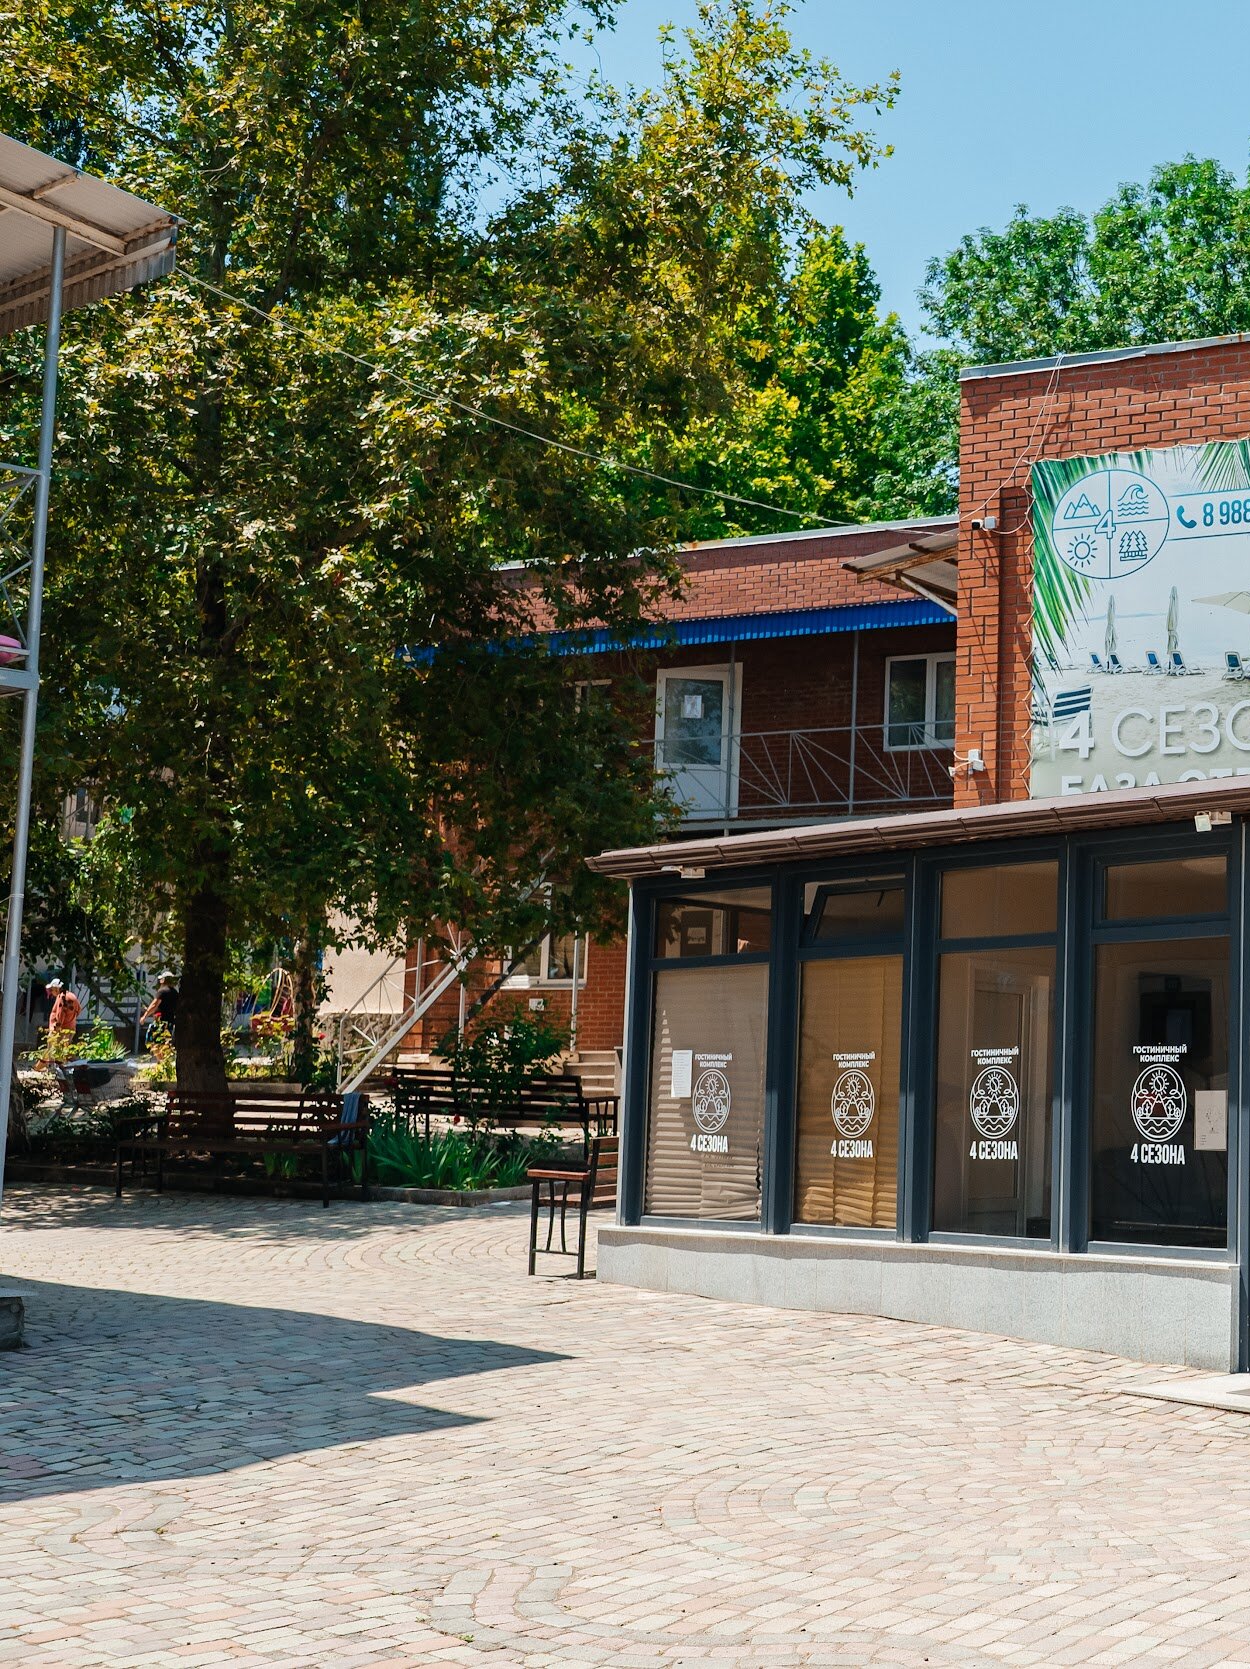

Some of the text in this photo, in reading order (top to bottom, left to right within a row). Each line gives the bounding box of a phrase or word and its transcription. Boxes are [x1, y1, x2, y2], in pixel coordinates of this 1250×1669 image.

[1095, 509, 1116, 539] 4
[1203, 502, 1214, 527] 8
[1059, 709, 1095, 759] 4
[694, 1053, 733, 1061] ГОСТИНИЧНЫЙ
[833, 1051, 876, 1061] ГОСТИНИЧНЫЙ
[971, 1046, 1019, 1057] ГОСТИНИЧНЫЙ
[1132, 1043, 1188, 1054] ГОСТИНИЧНЫЙ
[977, 1057, 1013, 1065] КОМПЛЕКС
[1139, 1054, 1180, 1063] КОМПЛЕКС
[690, 1134, 729, 1153] 4 СЕЗОНА
[830, 1140, 874, 1159] 4 СЕЗОНА
[969, 1140, 1019, 1160] 4 СЕЗОНА
[1130, 1143, 1186, 1165] 4 СЕЗОНА
